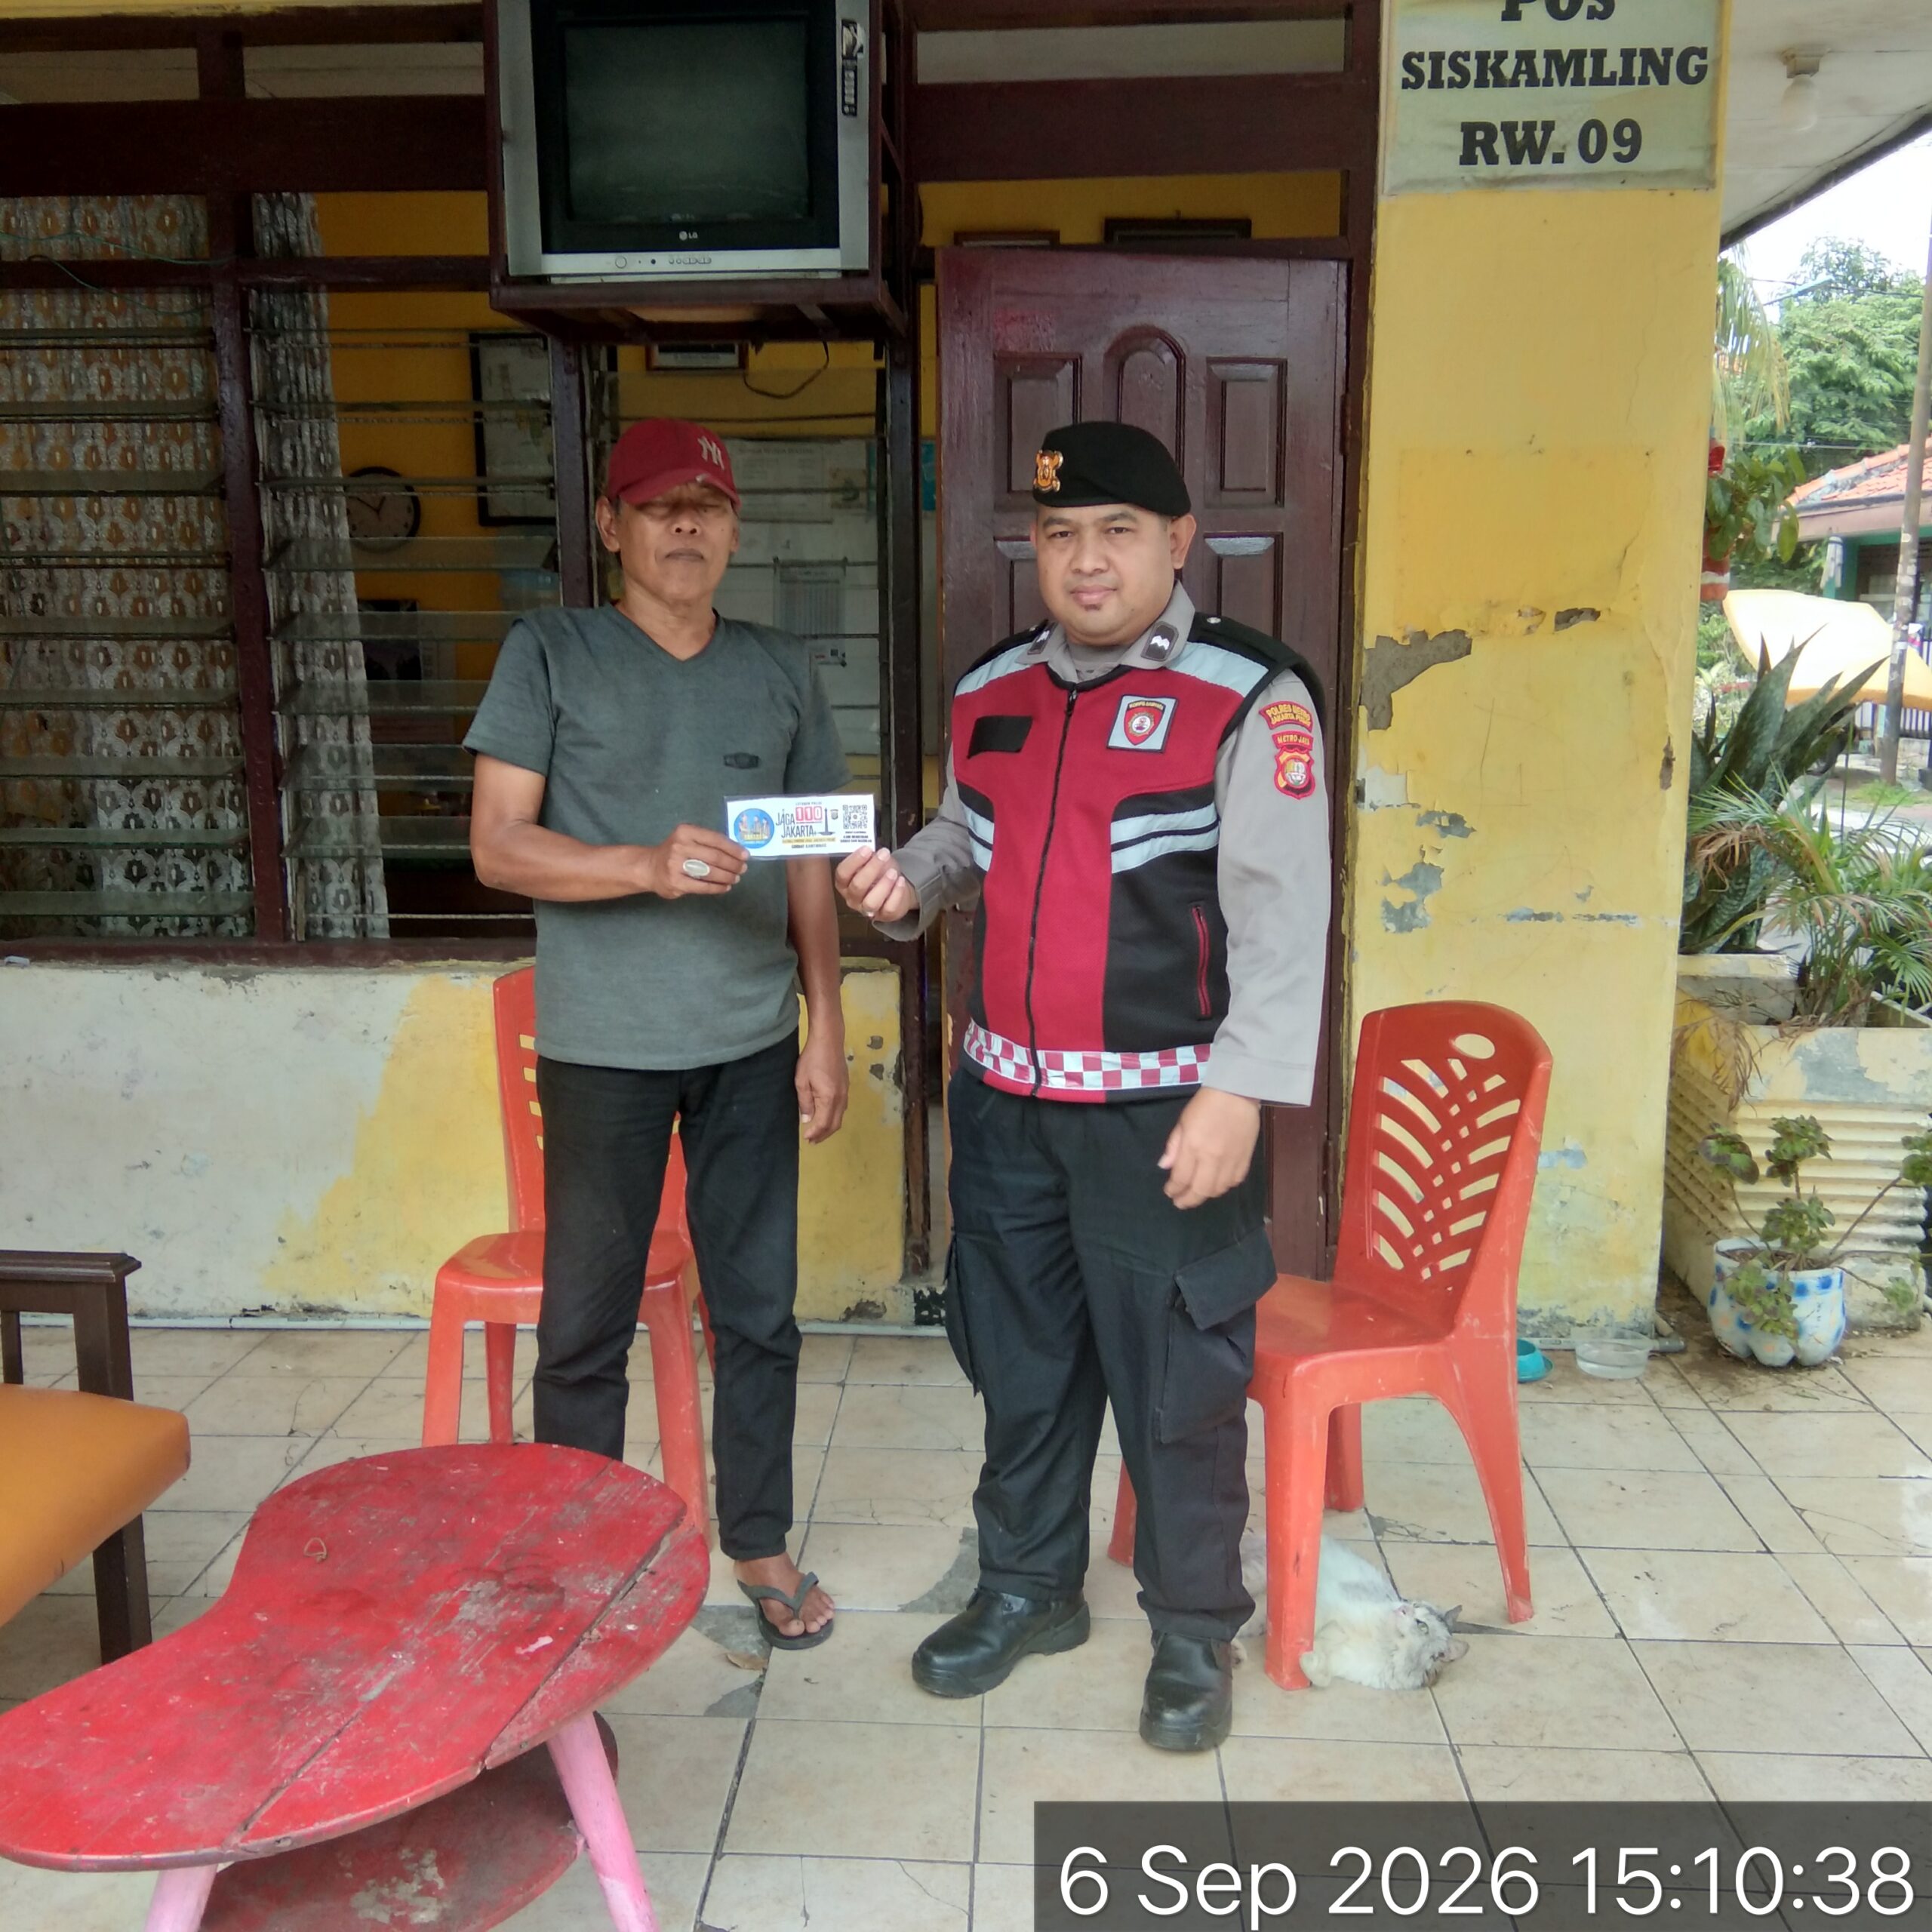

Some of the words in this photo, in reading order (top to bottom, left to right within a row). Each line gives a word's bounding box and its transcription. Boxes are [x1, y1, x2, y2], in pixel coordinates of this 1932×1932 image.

[1402, 47, 1708, 89] SISKAMLING
[1579, 118, 1641, 163] 09
[1277, 734, 1298, 743] METRO
[776, 811, 795, 826] JAGA
[796, 807, 822, 820] 110
